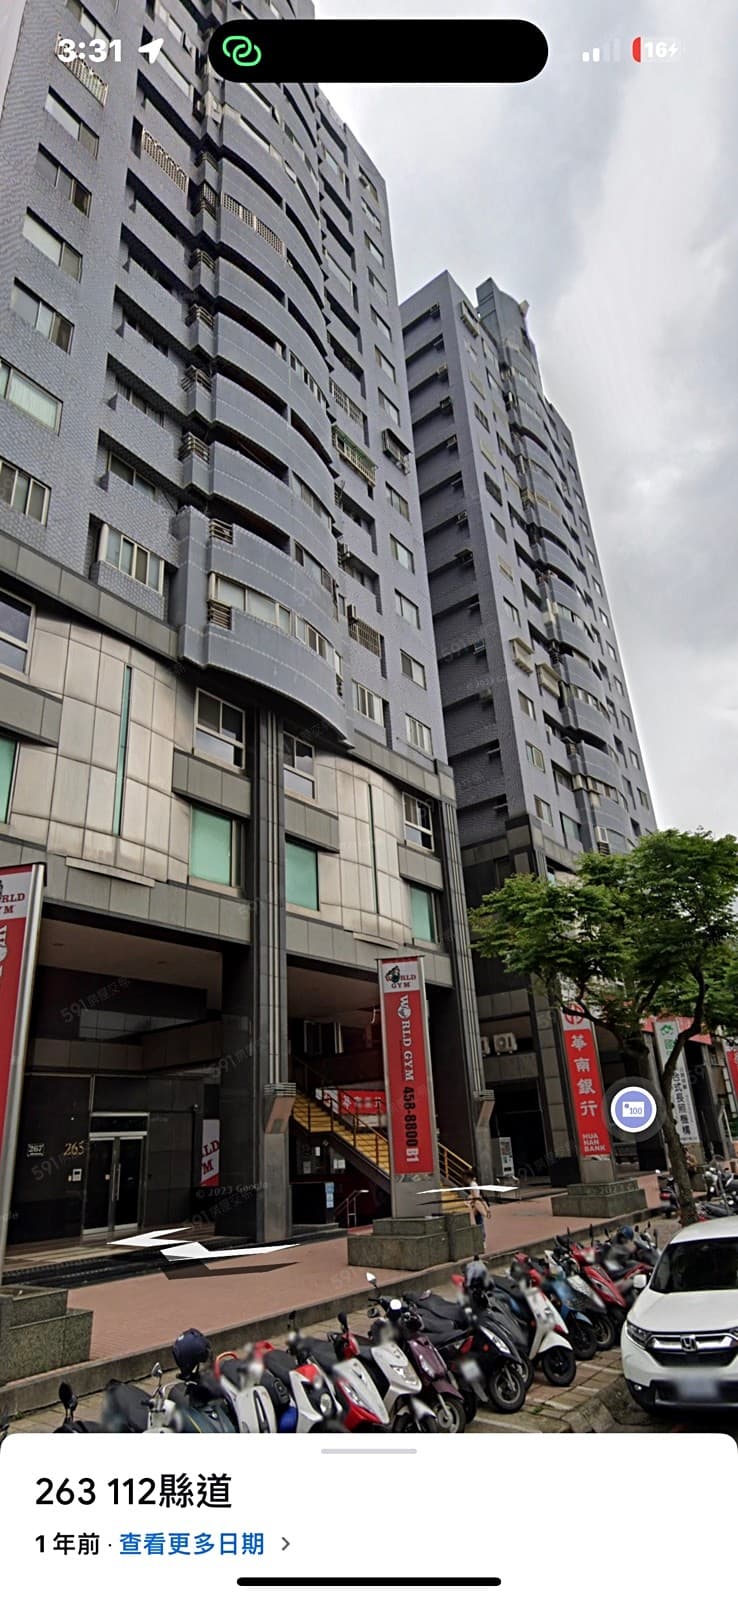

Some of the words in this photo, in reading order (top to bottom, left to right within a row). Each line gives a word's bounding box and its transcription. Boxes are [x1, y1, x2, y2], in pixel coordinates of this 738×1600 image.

[391, 981, 412, 990] GYM
[402, 1050, 415, 1081] GYM
[569, 1034, 598, 1117] 華南銀行
[402, 1086, 419, 1148] 458-8800
[63, 1140, 85, 1157] 265
